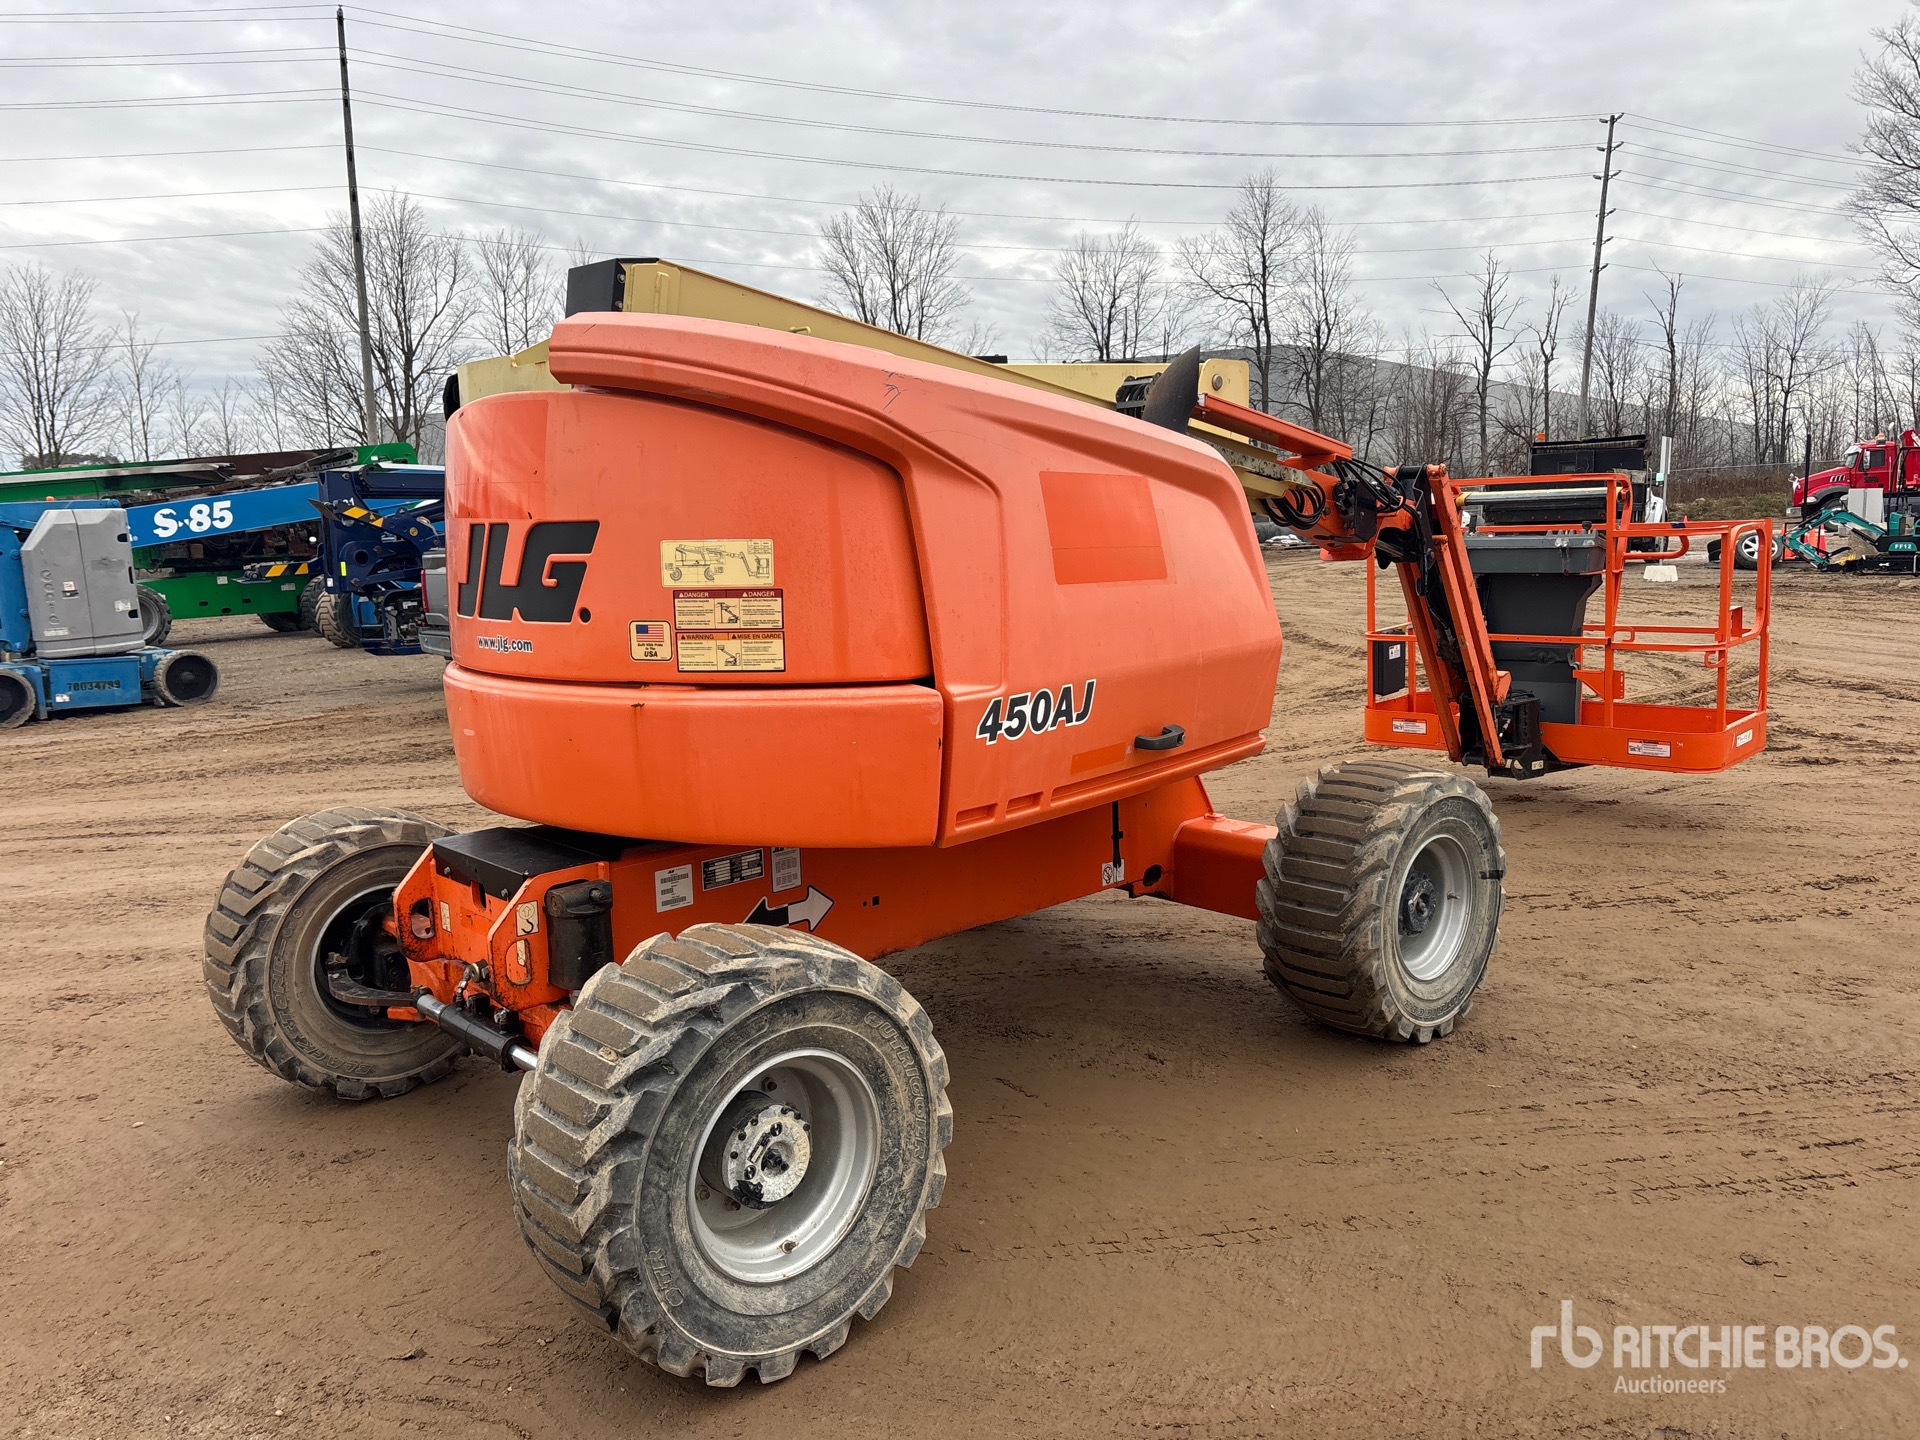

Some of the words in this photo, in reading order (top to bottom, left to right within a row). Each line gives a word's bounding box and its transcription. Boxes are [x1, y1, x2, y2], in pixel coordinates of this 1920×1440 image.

[457, 521, 600, 624] JLG
[478, 635, 533, 653] www.jlg.com
[976, 679, 1097, 745] 450AJ
[863, 1011, 927, 1161] OUTRIGGER
